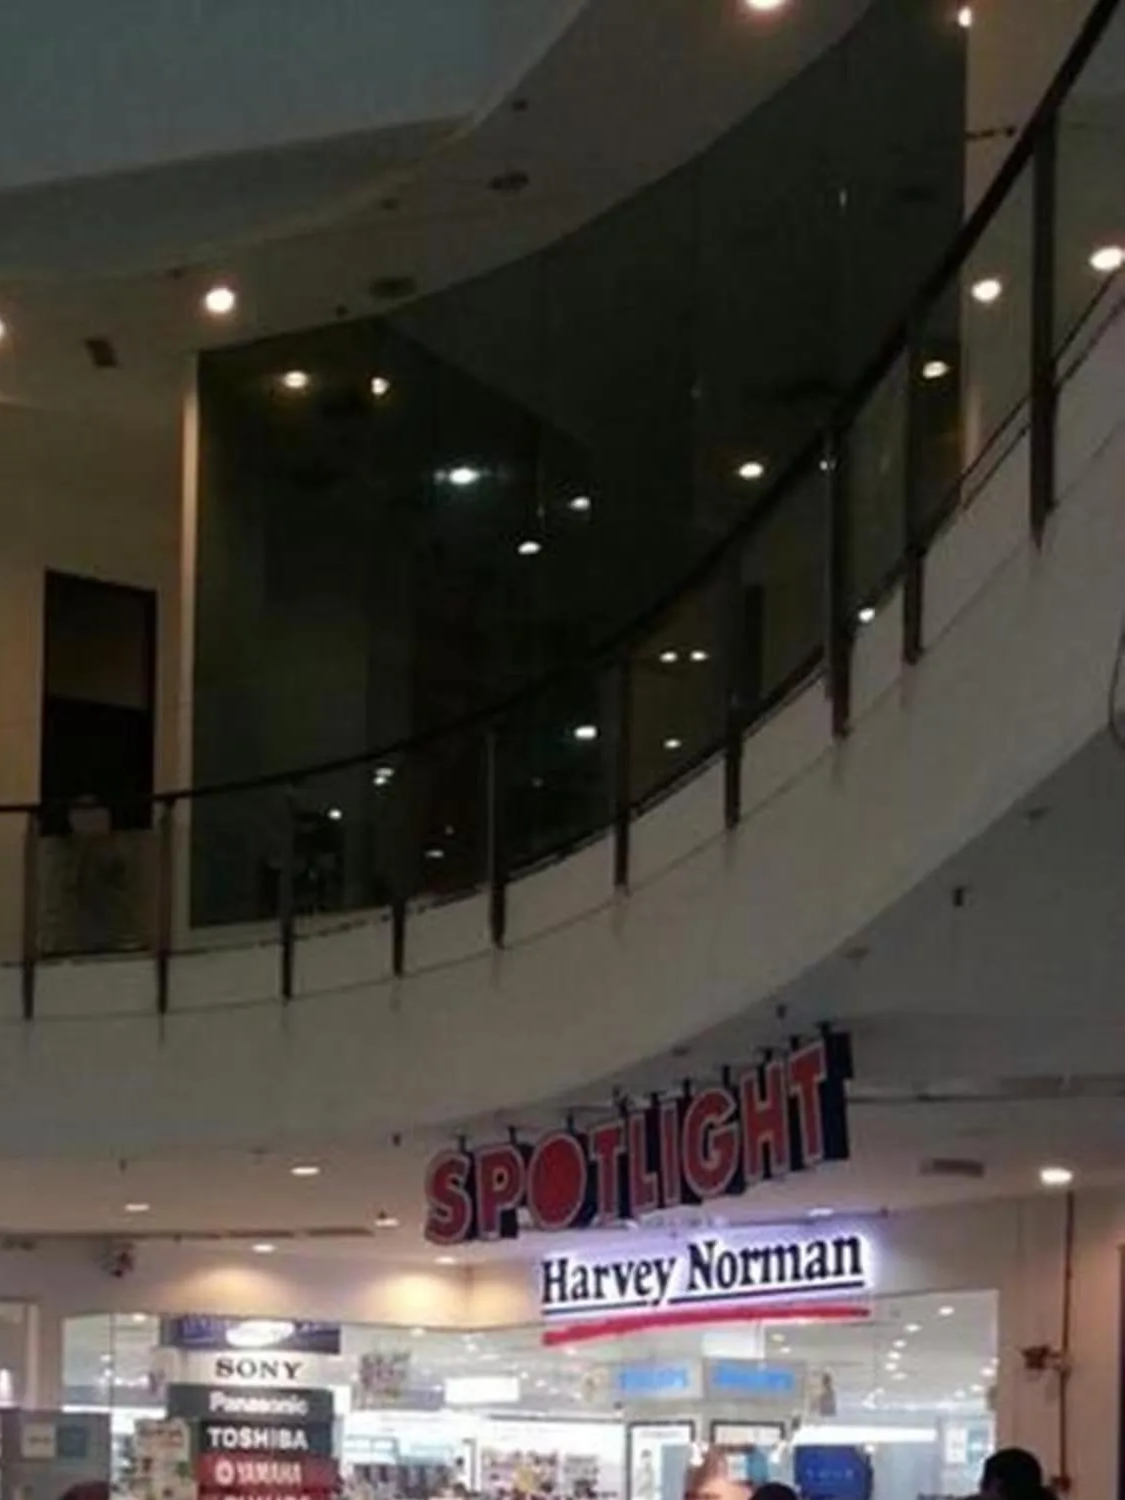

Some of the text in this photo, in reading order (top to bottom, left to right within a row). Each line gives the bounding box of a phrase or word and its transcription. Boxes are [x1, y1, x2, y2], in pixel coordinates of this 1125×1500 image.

[424, 1041, 828, 1245] SPOTLIGHT
[542, 1235, 863, 1305] Harvey Norman
[215, 1357, 303, 1379] SONY
[209, 1390, 309, 1416] Panasonic
[207, 1425, 309, 1450] TOSHIBA
